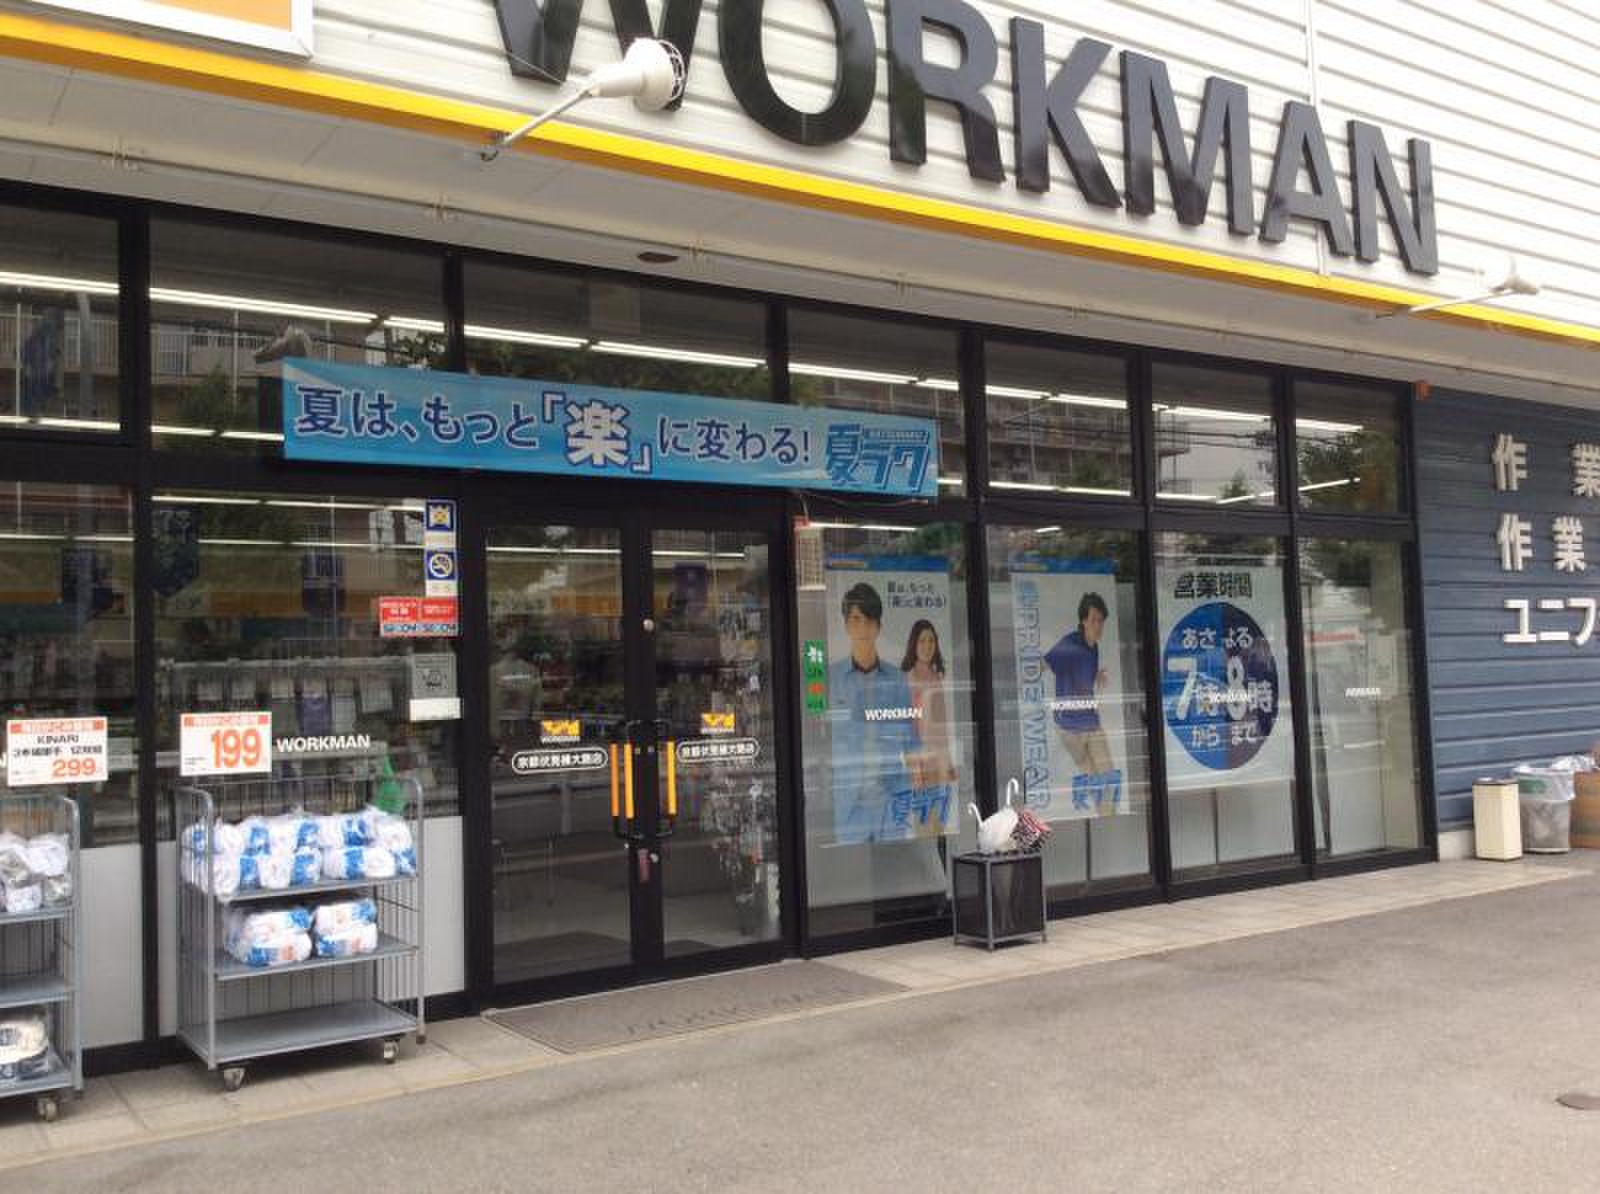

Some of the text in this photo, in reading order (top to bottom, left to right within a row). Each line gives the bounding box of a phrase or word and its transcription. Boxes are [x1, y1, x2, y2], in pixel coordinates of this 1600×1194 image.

[1503, 597, 1600, 647] ユニフ
[1182, 627, 1217, 649] あさ
[864, 707, 923, 721] WORKMAN
[212, 729, 262, 769] 199
[276, 735, 372, 753] WORKMAN
[52, 757, 97, 778] 299
